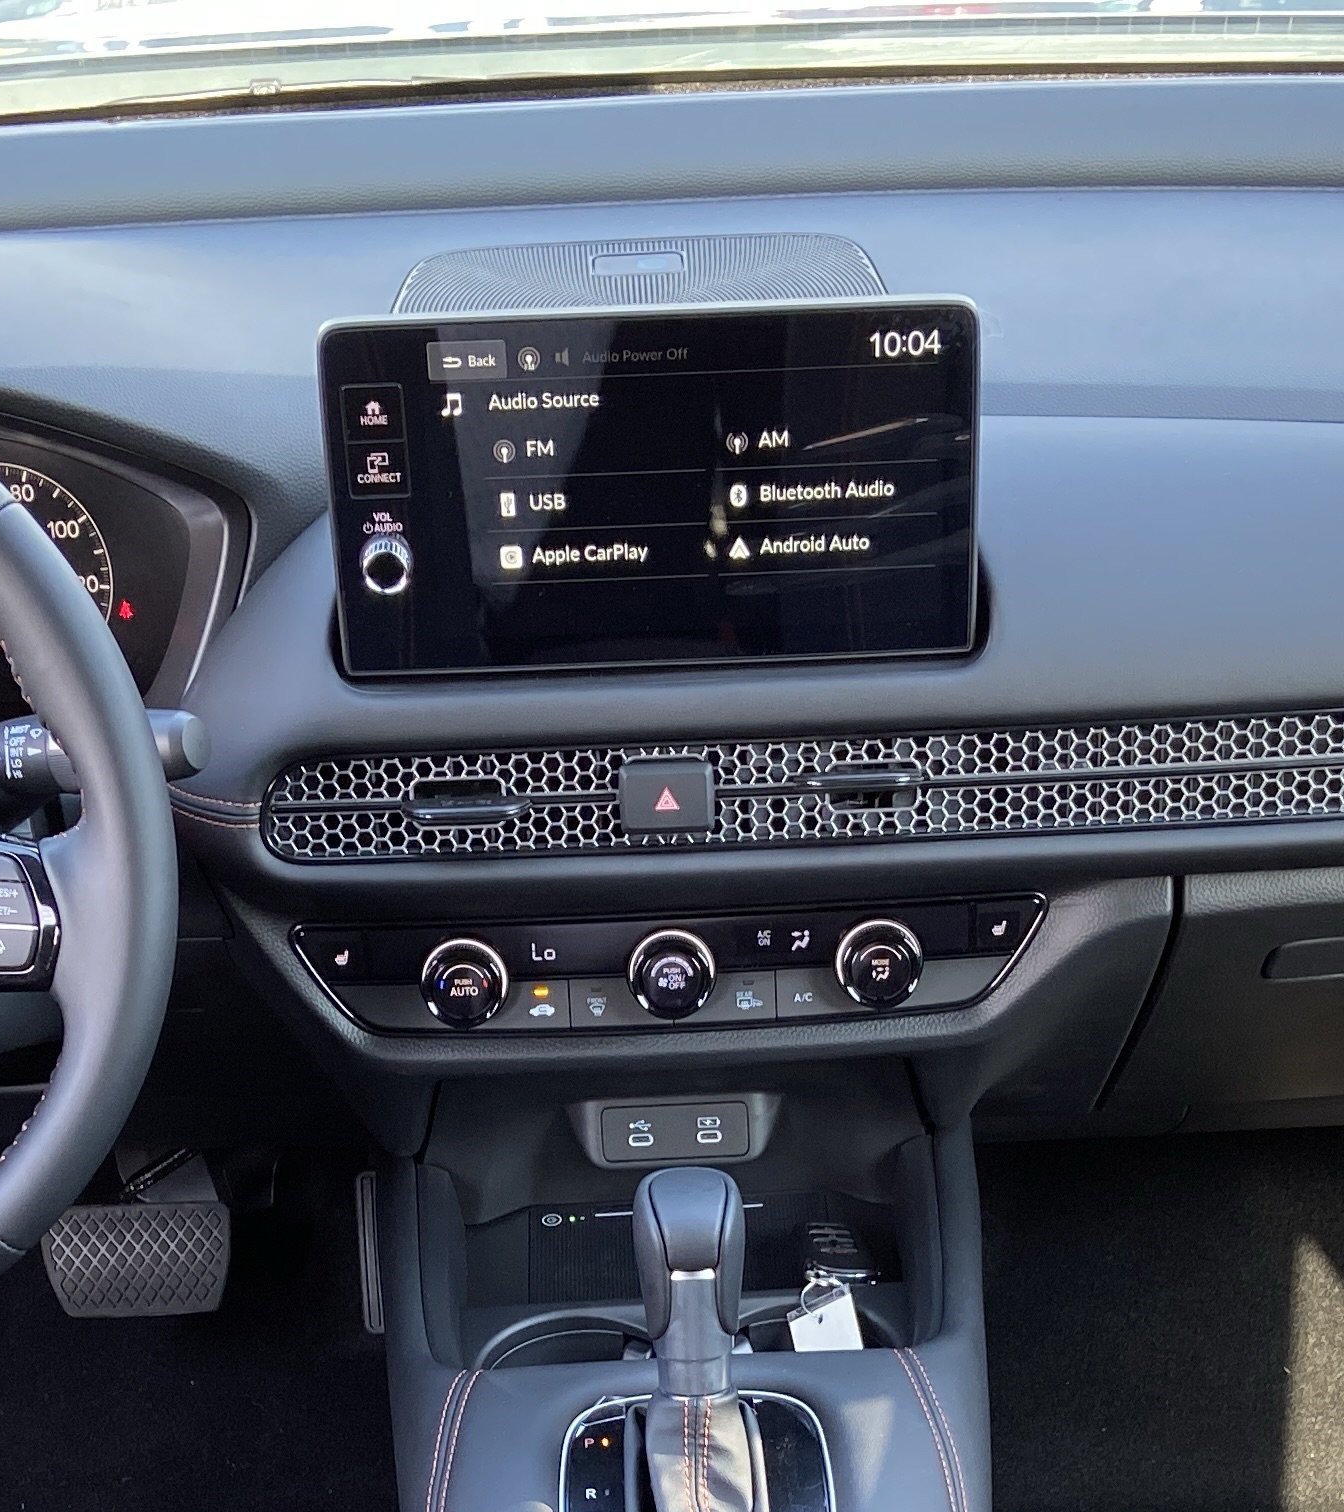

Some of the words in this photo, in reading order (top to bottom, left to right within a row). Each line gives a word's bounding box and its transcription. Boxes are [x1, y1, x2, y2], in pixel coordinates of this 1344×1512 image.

[868, 330, 942, 357] 10:04
[467, 353, 496, 368] Back
[582, 348, 619, 364] Audio
[623, 346, 662, 363] Power
[666, 346, 688, 361] Off
[488, 391, 537, 410] Audio
[542, 390, 599, 408] Source
[360, 414, 388, 426] HOME
[758, 431, 789, 448] AM
[525, 440, 554, 457] FM
[357, 472, 401, 484] CONNECT
[10, 484, 34, 502] 80
[759, 481, 839, 501] Bluetooth
[845, 480, 894, 498] Audio
[529, 493, 566, 511] USB
[373, 512, 393, 522] VOL
[47, 520, 80, 539] 100
[374, 522, 403, 533] AUDIO
[759, 535, 825, 554] Android
[829, 534, 870, 553] Auto
[532, 546, 579, 566] Apple
[583, 544, 648, 565] CarPlay
[9, 736, 26, 747] OFF
[11, 758, 23, 769] LO
[758, 938, 771, 946] ON
[531, 943, 556, 960] Lo
[450, 986, 479, 997] AUTO
[793, 992, 813, 1002] A/C
[586, 996, 608, 1005] FRONT
[584, 1438, 595, 1449] P
[585, 1487, 597, 1499] R
